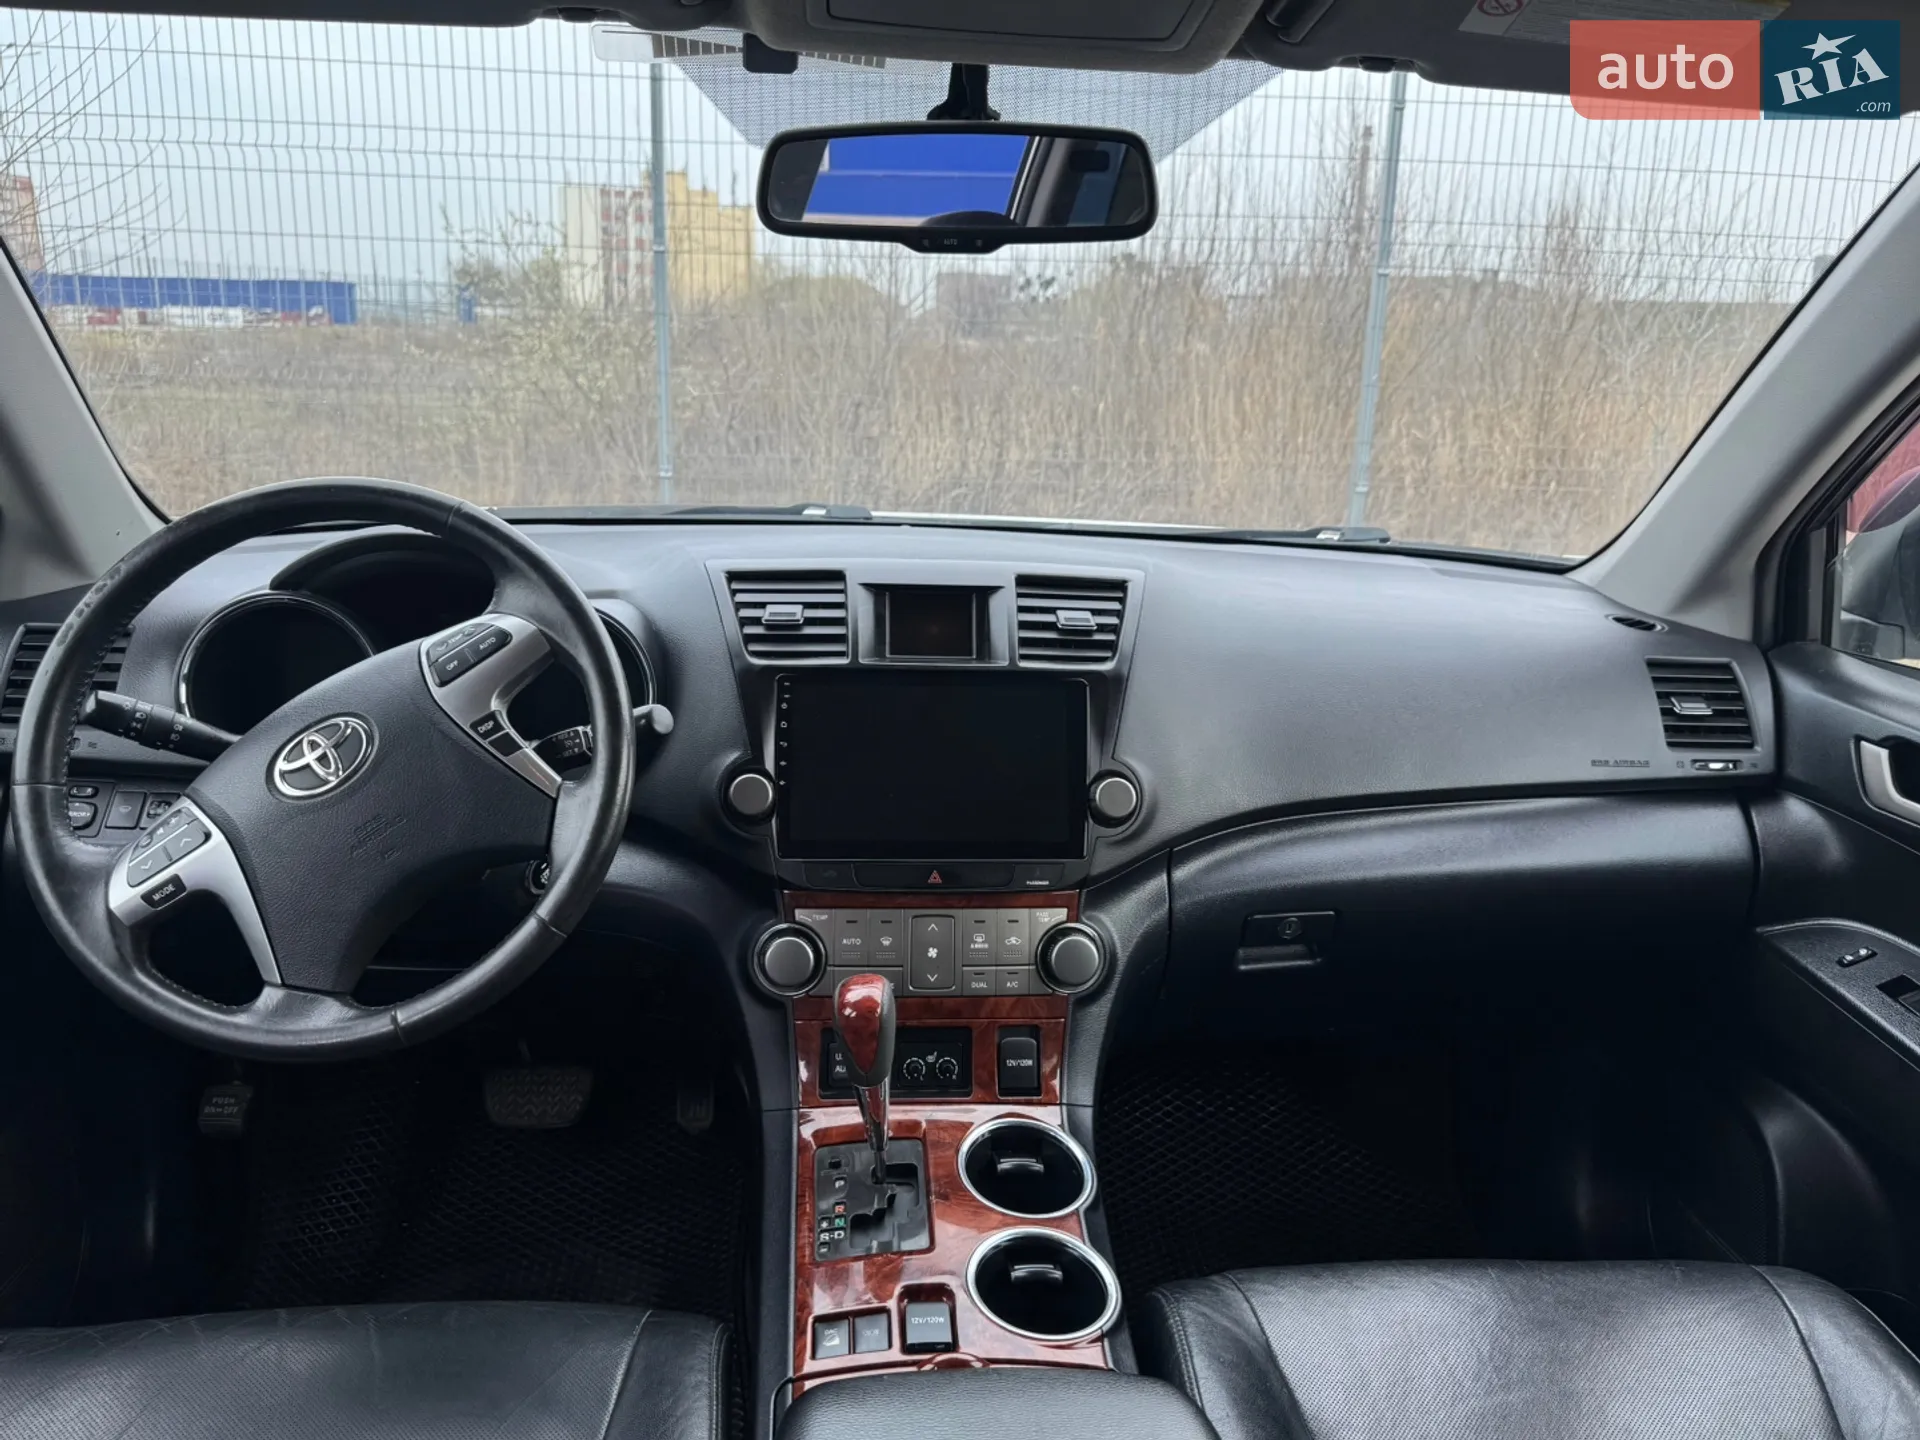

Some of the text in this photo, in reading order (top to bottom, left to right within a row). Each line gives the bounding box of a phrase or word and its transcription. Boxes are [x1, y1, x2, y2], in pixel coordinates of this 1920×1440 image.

[478, 636, 497, 650] AUTO
[445, 659, 459, 671] OFF
[477, 720, 495, 734] DISP
[151, 882, 176, 901] MODE
[841, 938, 862, 946] AUTO
[970, 981, 988, 989] DUAL
[1006, 980, 1019, 988] A/C
[834, 1180, 845, 1188] P
[834, 1205, 845, 1214] R
[834, 1218, 845, 1227] N
[910, 1315, 945, 1324] 12V/120W
